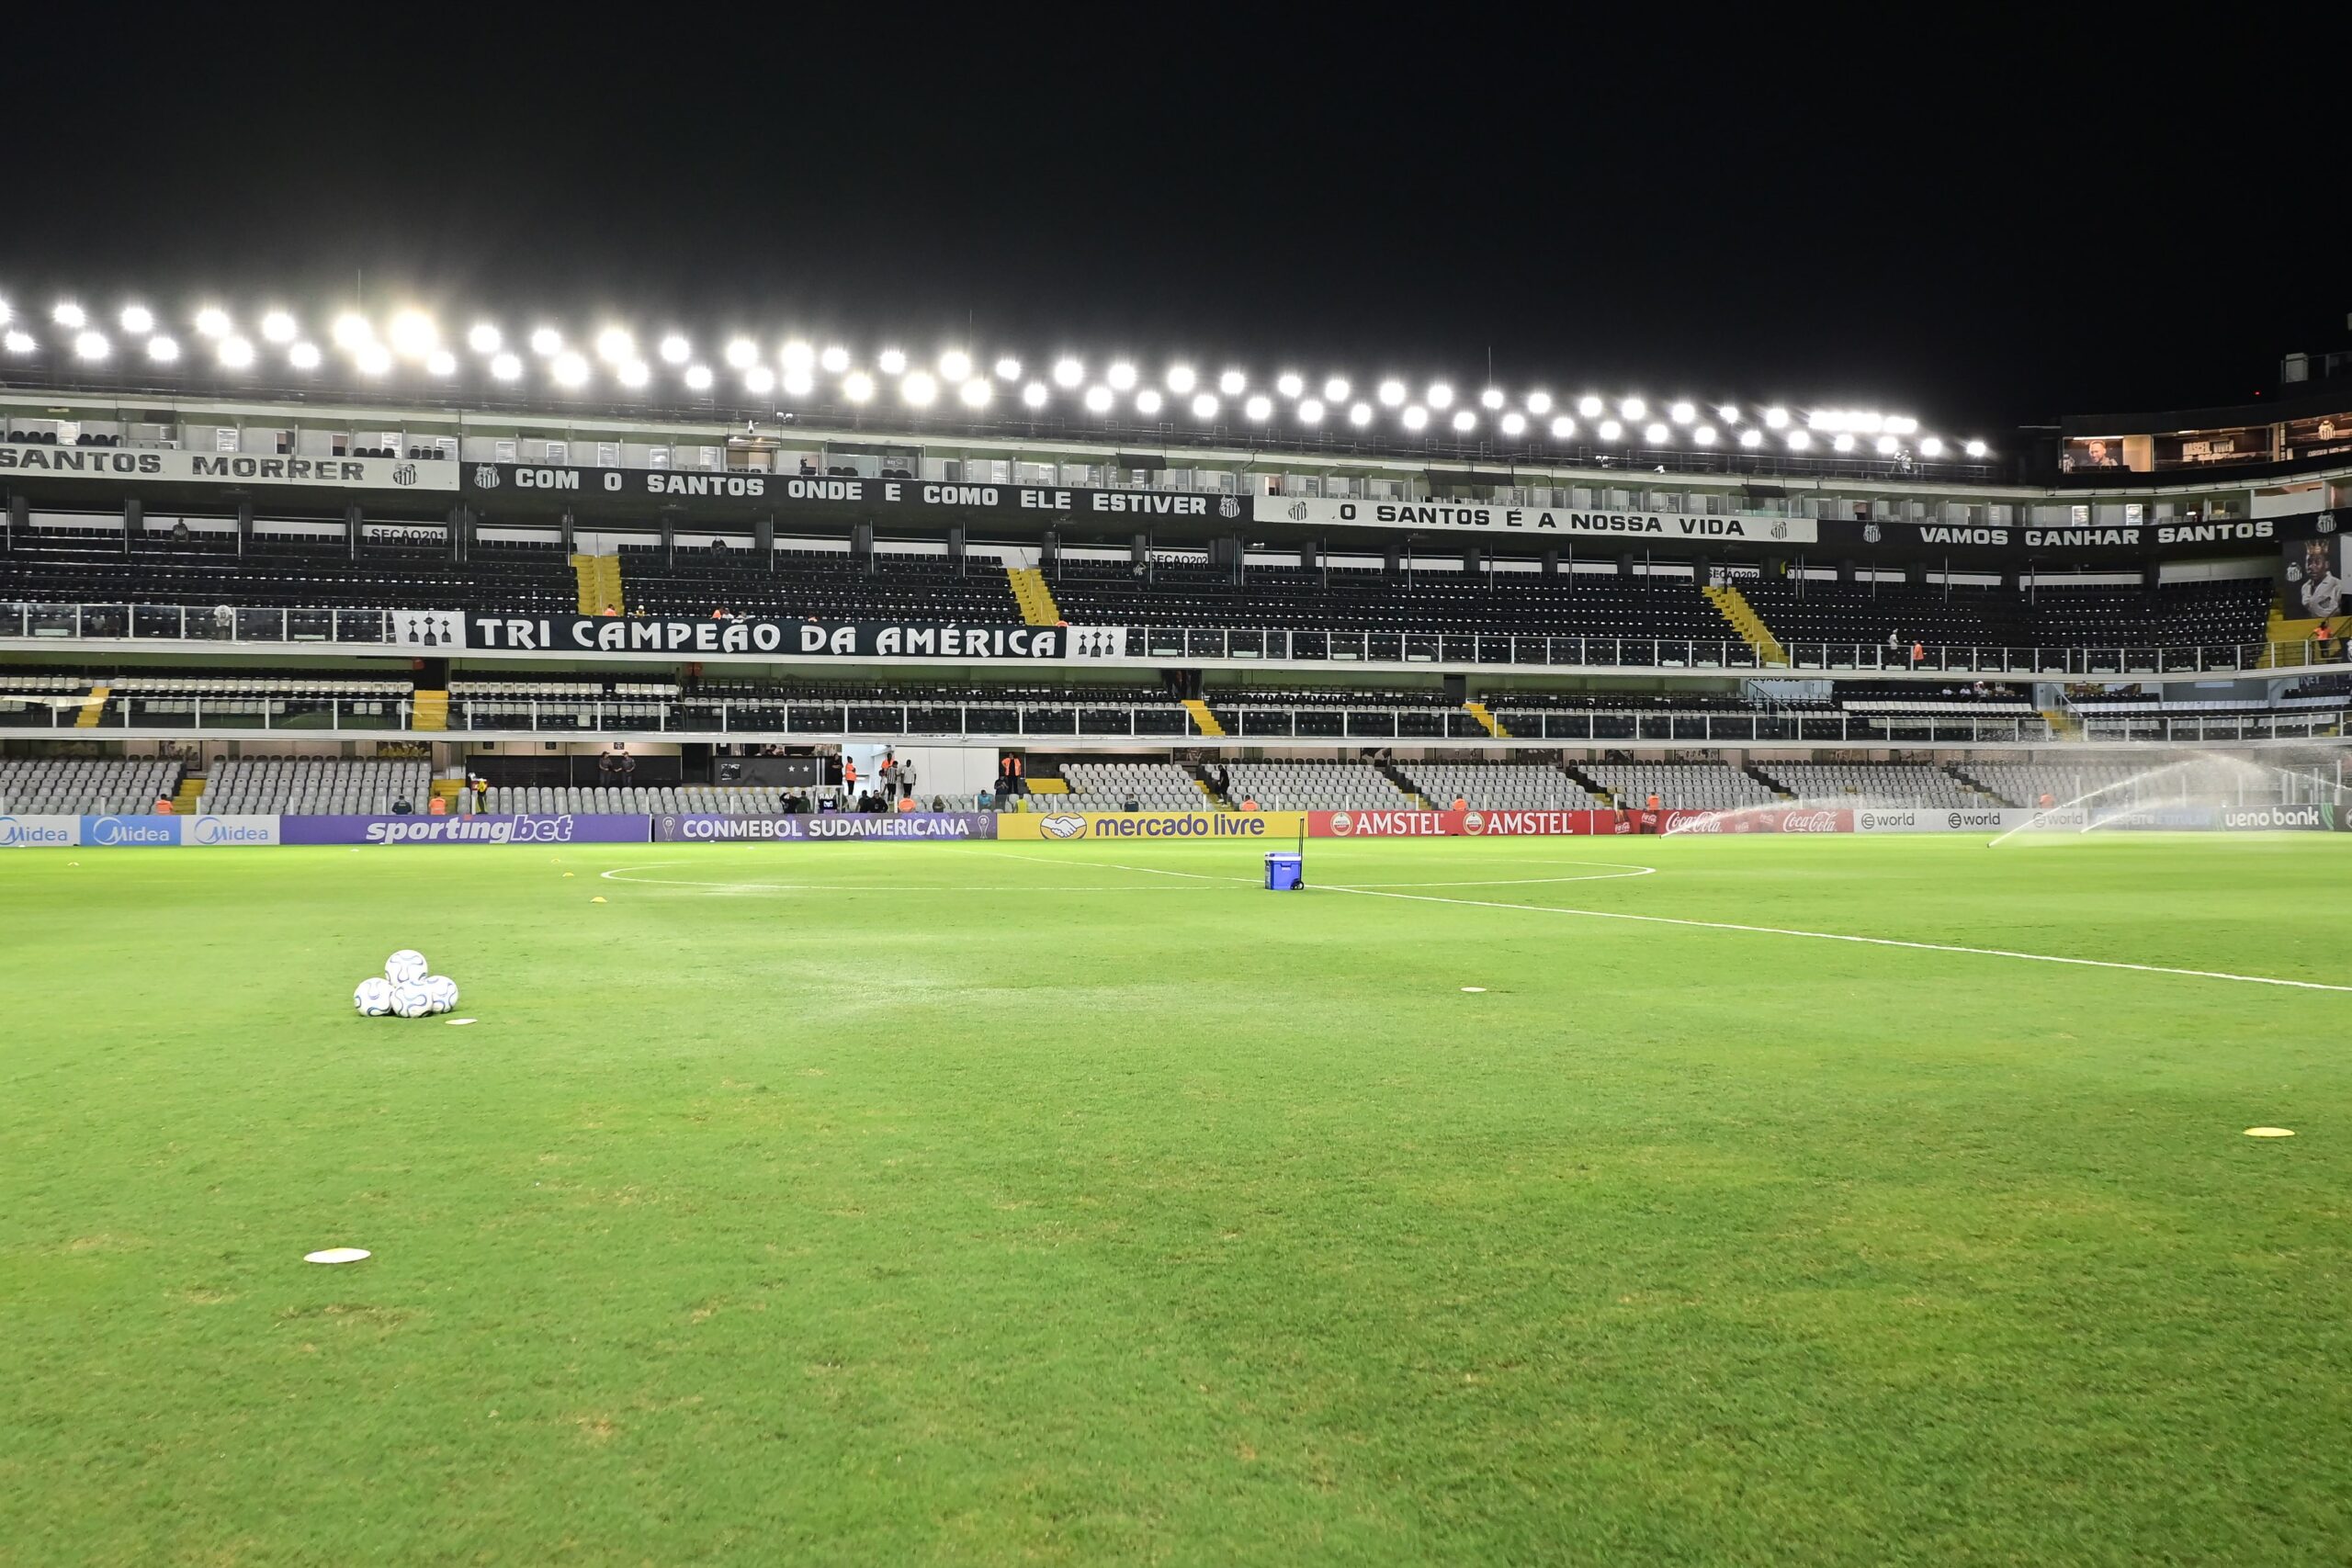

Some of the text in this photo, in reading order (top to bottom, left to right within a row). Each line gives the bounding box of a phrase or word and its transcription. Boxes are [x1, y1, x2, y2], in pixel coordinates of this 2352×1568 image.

[0, 447, 364, 480] SANTOS MORRER
[515, 468, 1206, 515] COM O SANTOS ONDE E COMO ELE ESTIVER
[1340, 504, 1746, 536] O SANTOS É A NOSSA VIDA
[1920, 521, 2274, 546] VAMOS GANHAR SANTOS
[476, 618, 1056, 658] TRI CAMPEÃO DA AMÉRICA
[684, 818, 969, 837] CONMEBOL SUDAMERICANA
[1095, 814, 1264, 836] mercado livre
[1355, 812, 1445, 834] AMSTEL
[1487, 812, 1573, 833] AMSTEL
[1783, 811, 1838, 832] Coca-Cola
[1877, 813, 1915, 826] world
[1963, 813, 2000, 825] world
[2046, 812, 2083, 825] world
[2226, 807, 2319, 827] ueno bank
[6, 827, 67, 843] Midea
[102, 826, 170, 842] Midea
[204, 826, 268, 842] Midea
[367, 815, 572, 844] sportingbet
